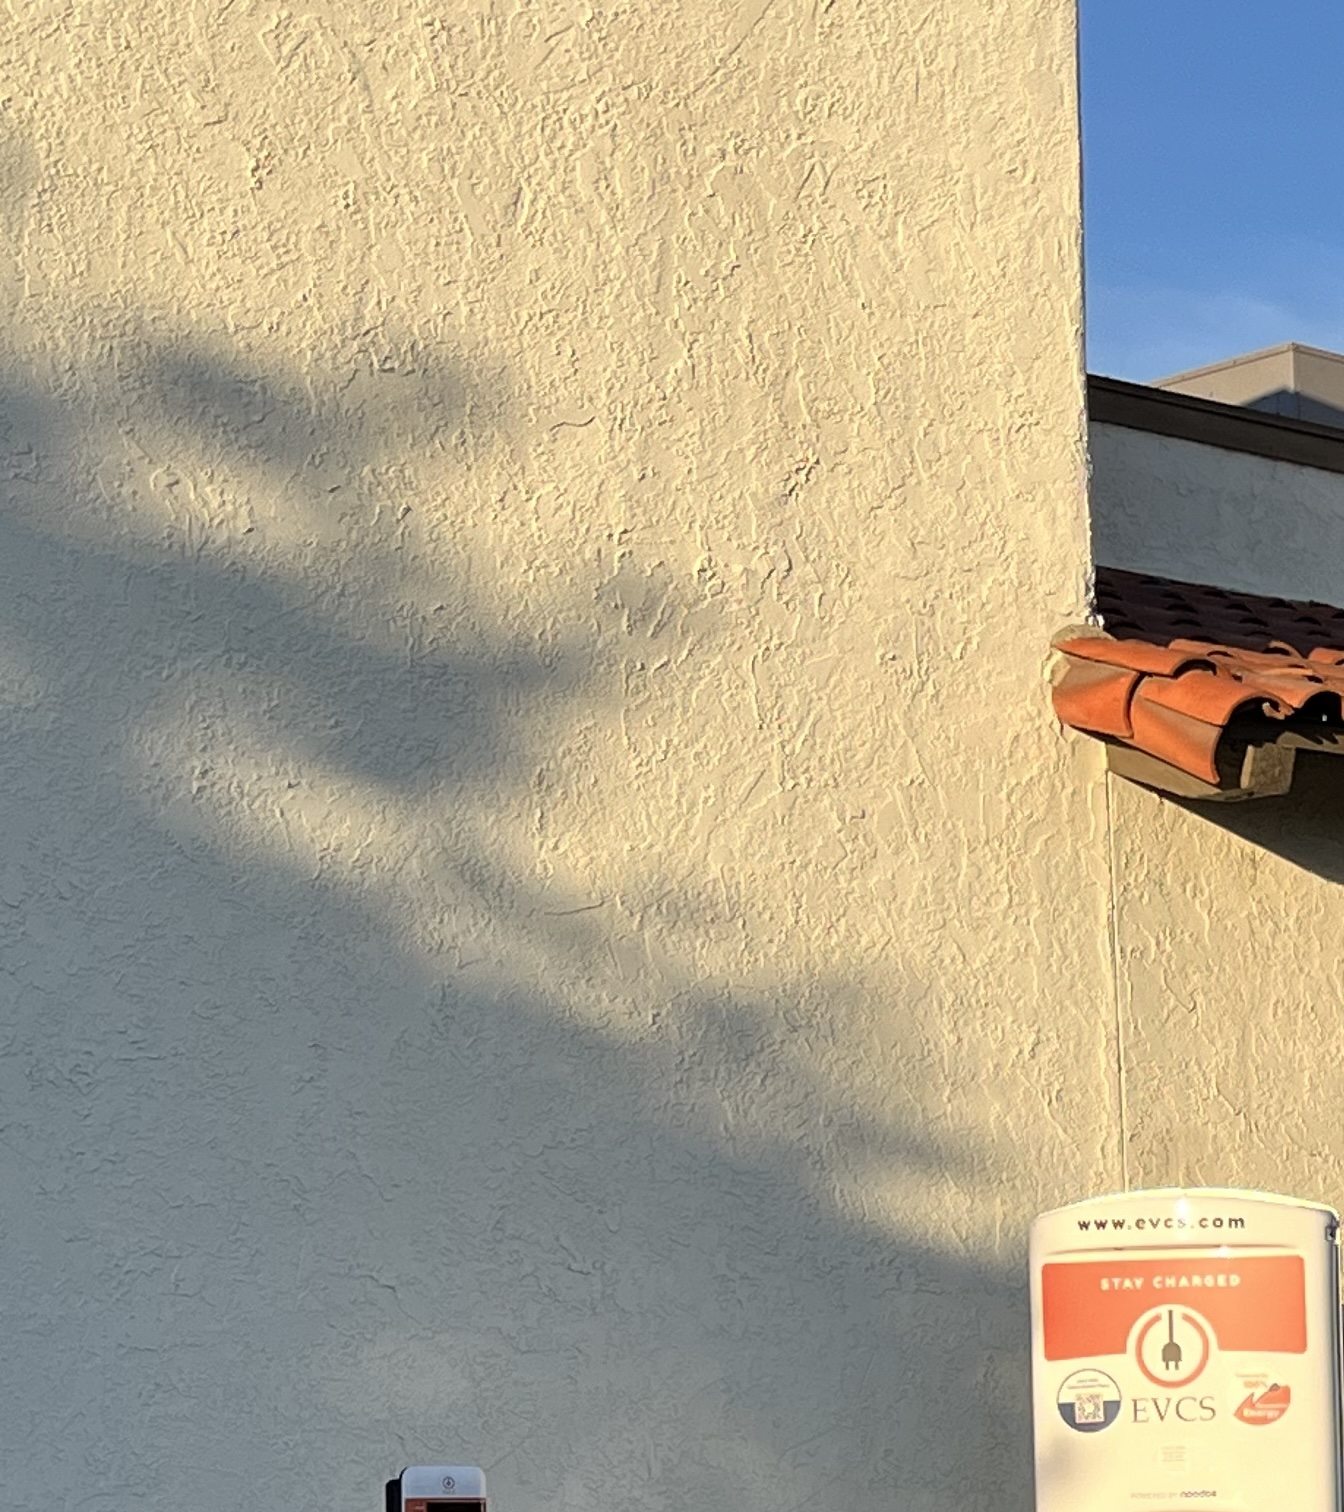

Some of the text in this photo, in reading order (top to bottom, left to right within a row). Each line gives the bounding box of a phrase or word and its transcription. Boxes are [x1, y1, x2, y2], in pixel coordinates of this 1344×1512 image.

[1077, 1215, 1246, 1231] www.evcs.com
[1100, 1273, 1242, 1291] STAY CHARGED
[1131, 1395, 1217, 1424] EVCS
